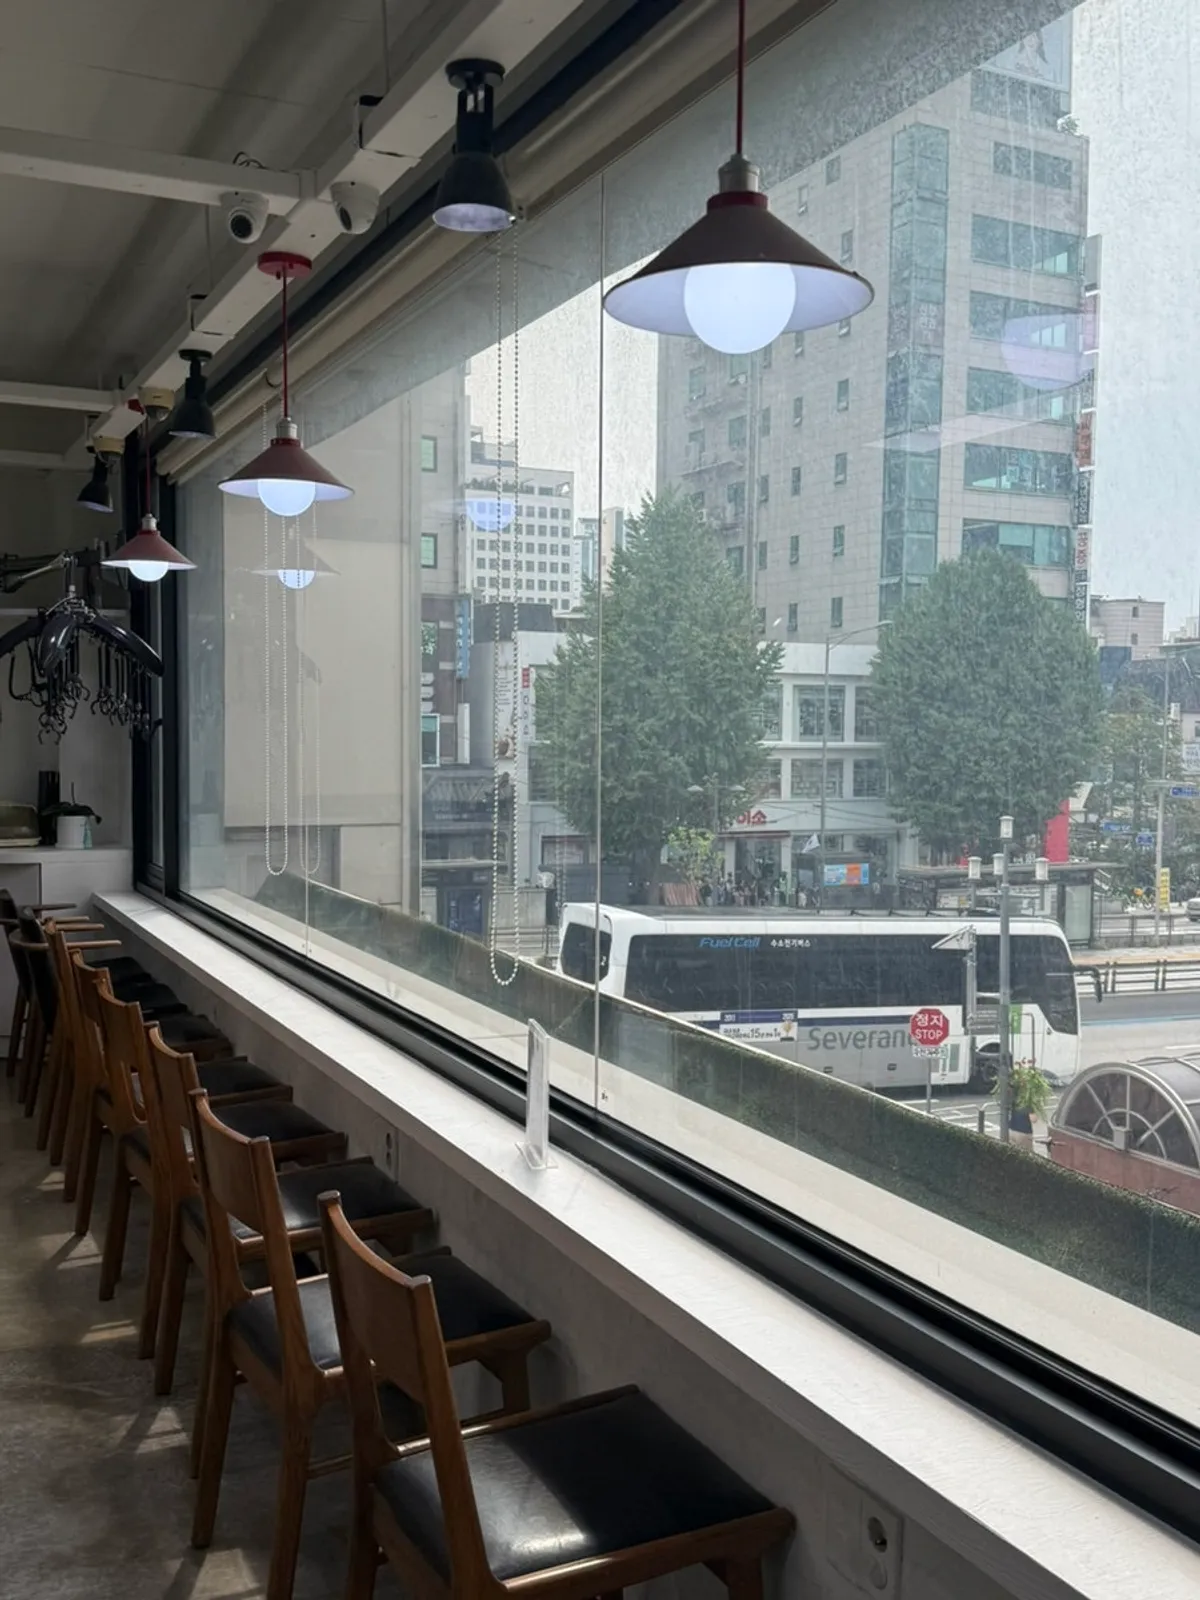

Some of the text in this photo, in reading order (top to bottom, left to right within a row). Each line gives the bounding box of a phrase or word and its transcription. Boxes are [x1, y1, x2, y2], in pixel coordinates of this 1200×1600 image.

[737, 809, 767, 825] 이소
[699, 936, 761, 948] Fuel Cell
[916, 1013, 944, 1028] 정지
[808, 1028, 917, 1050] Severan
[915, 1028, 943, 1040] STOP
